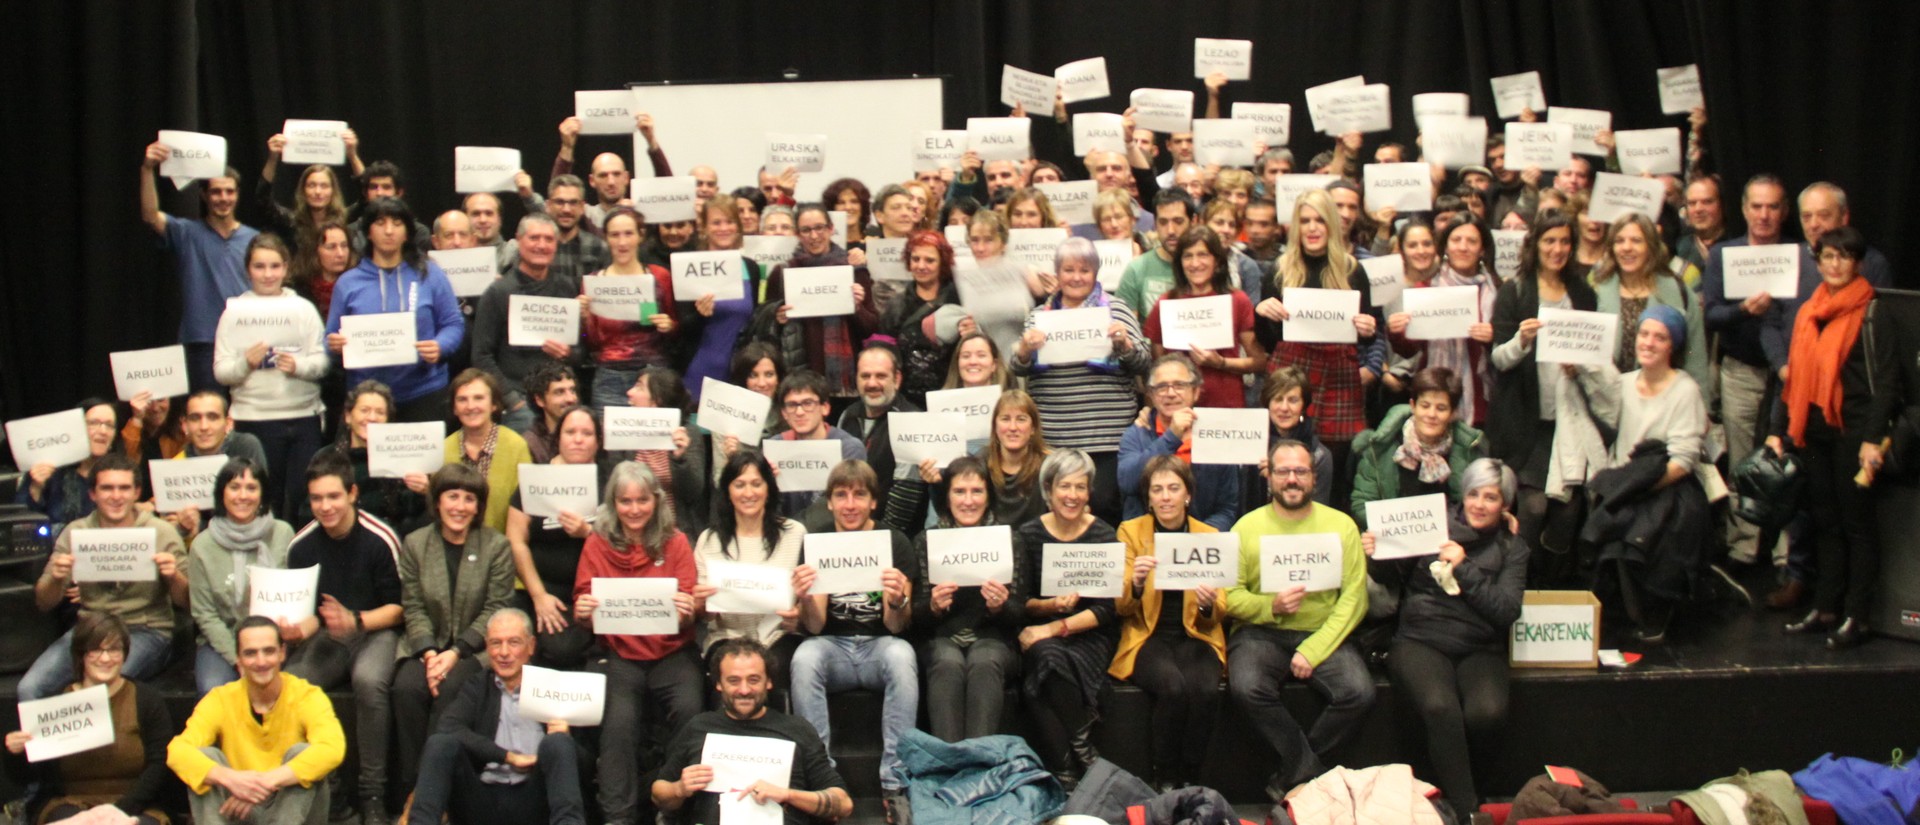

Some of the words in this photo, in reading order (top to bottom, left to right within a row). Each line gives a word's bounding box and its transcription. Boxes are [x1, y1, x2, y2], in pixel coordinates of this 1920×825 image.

[1204, 49, 1239, 57] LEZAO
[1064, 75, 1096, 85] ADANA
[586, 108, 629, 117] OZAETA
[1237, 114, 1283, 122] HERRIKO
[1255, 126, 1283, 134] ERNA
[771, 143, 819, 153] URASKA
[925, 138, 954, 149] ELA
[172, 149, 210, 159] ELGEA
[1626, 147, 1669, 156] EGILEOR
[1374, 179, 1420, 187] AGURAIN
[1605, 187, 1651, 200] JOTAFA
[638, 194, 689, 204] AUDIKANA
[754, 253, 794, 262] OPAKU
[1732, 257, 1790, 267] JUBILATUEN
[443, 265, 490, 276] RGOMANIZ
[685, 260, 727, 277] AEK
[1738, 267, 1784, 276] ELKARTEA
[594, 287, 642, 295] ORBELA
[801, 285, 838, 294] ALBEIZ
[521, 303, 567, 315] ACICSA
[1411, 308, 1471, 318] GALARRETA
[521, 316, 567, 324] MERKATARI
[1178, 309, 1214, 321] HAIZE
[1296, 310, 1344, 320] ANDOIN
[236, 318, 291, 326] ALANGUA
[352, 330, 377, 338] HERRI
[380, 329, 405, 337] KIROL
[522, 325, 564, 333] ELKARTEA
[1046, 329, 1102, 342] ARRIETA
[1548, 329, 1603, 341] IKASTETXE
[1549, 341, 1600, 352] PUBLIKOA
[126, 367, 173, 380] ARBULU
[706, 399, 757, 423] DURRUMA
[613, 419, 671, 428] KROMLETX
[385, 434, 426, 442] KULTURA
[897, 433, 958, 443] AMETZAGA
[1199, 429, 1261, 440] ERENTXUN
[27, 433, 71, 450] EGINO
[376, 444, 437, 452] ELKARGUNEA
[777, 460, 829, 470] EGILETA
[164, 474, 216, 487] BERTSO
[166, 489, 212, 500] ESKOL
[529, 485, 587, 496] DULANTZI
[1381, 509, 1432, 524] LAUTADA
[1382, 523, 1438, 537] IKASTOLA
[79, 542, 149, 553] MARISORO
[90, 555, 137, 563] EUSKARA
[942, 551, 999, 565] AXPURU
[1062, 550, 1107, 558] ANITURRI
[1173, 548, 1220, 565] LAB
[818, 555, 879, 569] MUNAIN
[1052, 560, 1115, 569] INSTITUTUKO
[1272, 553, 1330, 566] AHT-RIK
[96, 564, 133, 572] TALDEA
[1168, 570, 1225, 579] SINDIKATUA
[1289, 570, 1310, 582] EZ!
[1058, 579, 1108, 587] ELKARTEA
[257, 588, 310, 603] ALAITZA
[605, 598, 664, 608] BULTZADA
[600, 609, 670, 619] TXURI-URDIN
[1515, 621, 1592, 642] EKARPENAK
[532, 688, 592, 702] ILARDUIA
[37, 701, 93, 724] MUSIKA
[41, 716, 94, 738] BANDA
[711, 752, 783, 765] EZKEREKOTXA
